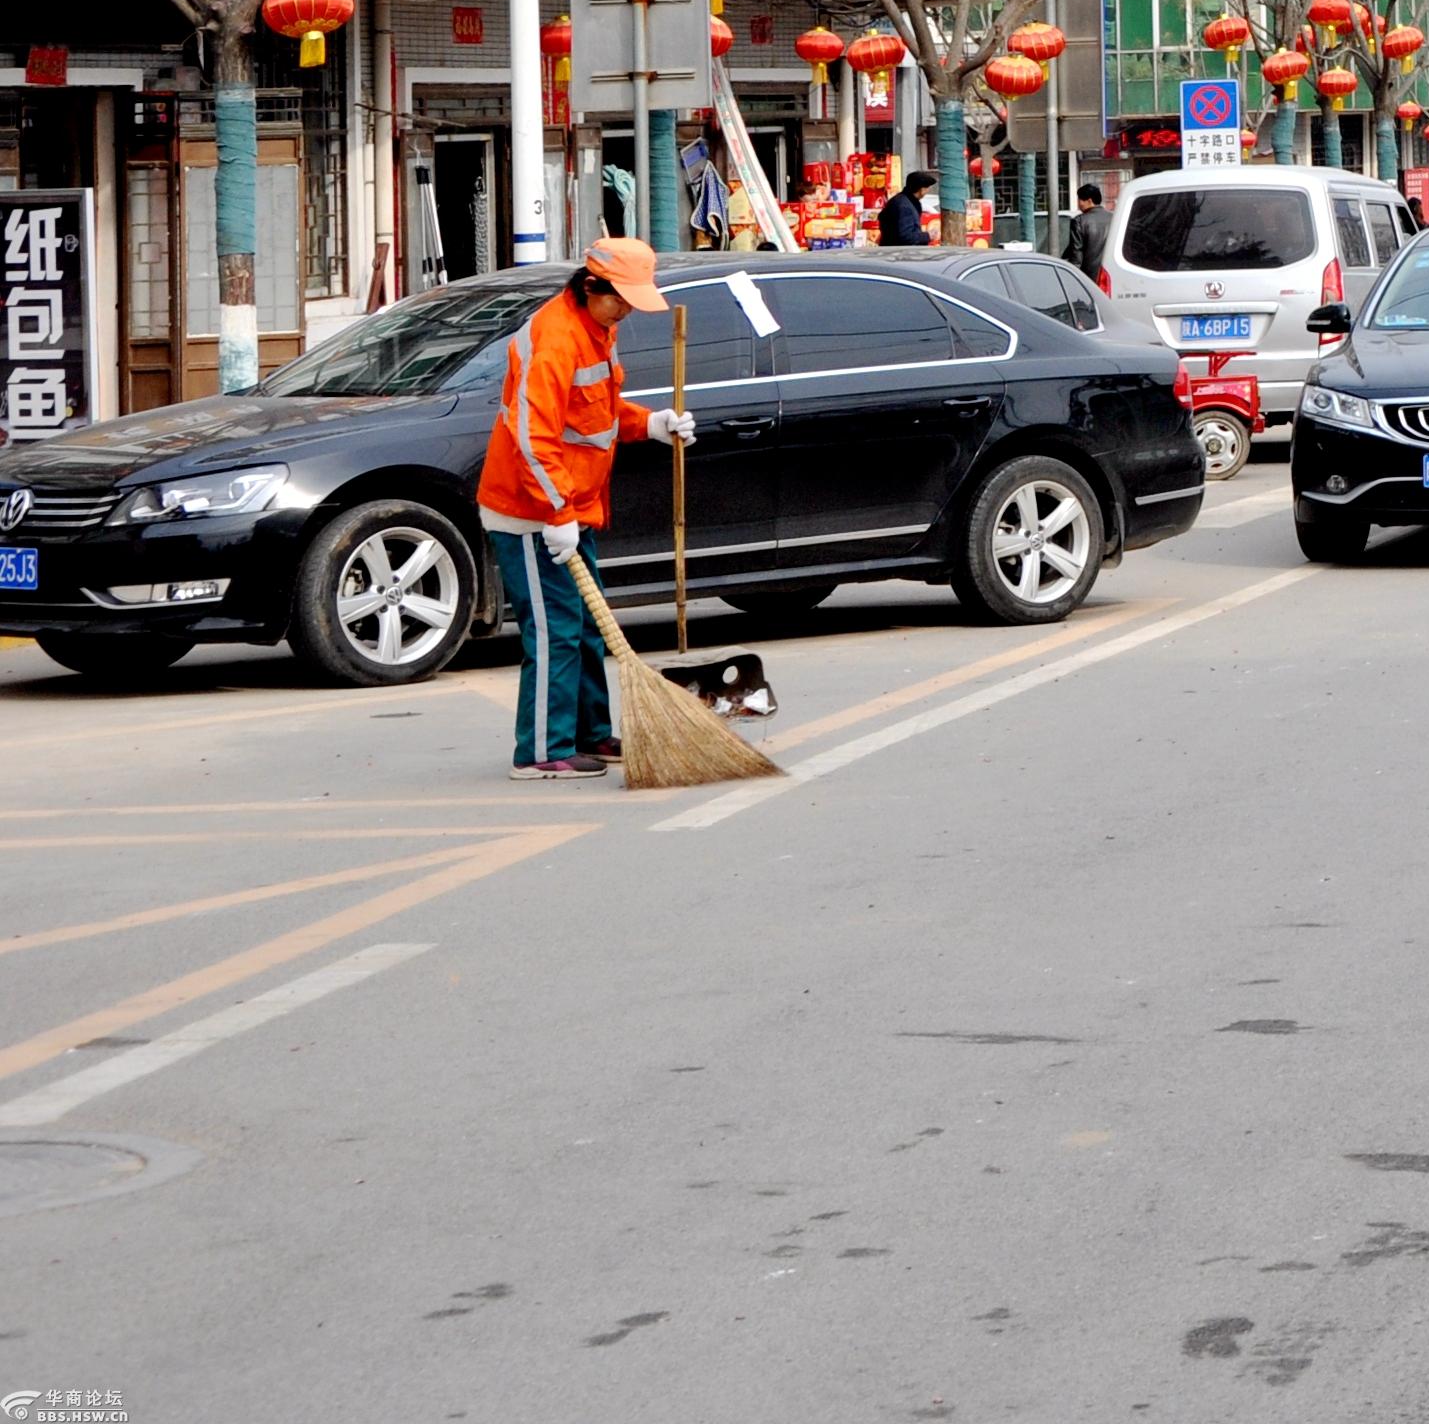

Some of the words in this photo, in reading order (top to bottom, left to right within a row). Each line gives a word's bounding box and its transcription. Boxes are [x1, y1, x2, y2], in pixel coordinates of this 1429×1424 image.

[1187, 134, 1235, 148] 十字路口
[1187, 152, 1237, 165] 严禁停车
[4, 207, 67, 439] 纸包鱼
